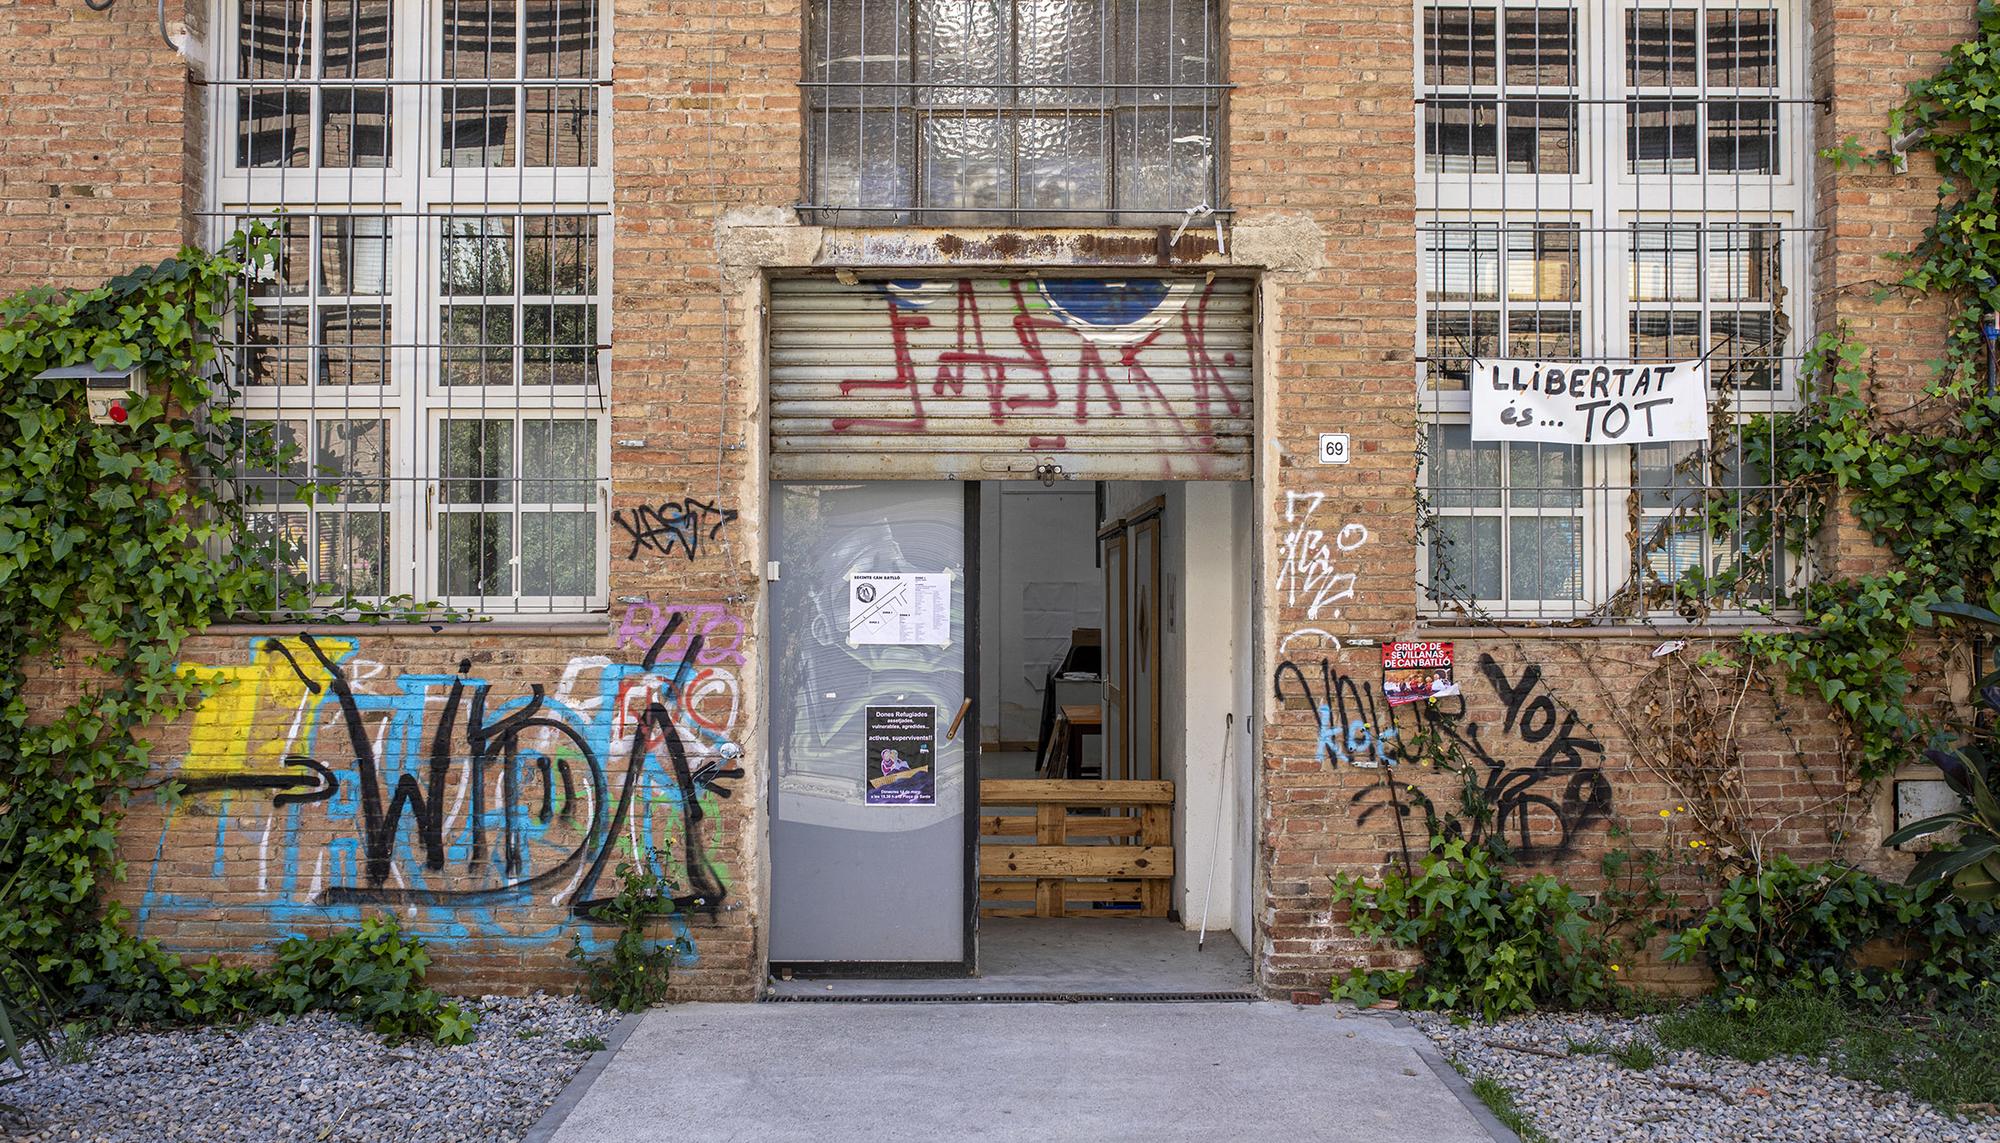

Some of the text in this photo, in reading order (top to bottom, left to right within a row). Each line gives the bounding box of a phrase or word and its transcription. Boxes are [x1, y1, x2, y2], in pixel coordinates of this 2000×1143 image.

[1576, 398, 1674, 442] TOT
[1326, 441, 1344, 456] 69
[1394, 643, 1427, 651] GRUPO
[1391, 650, 1444, 659] SEVILLANAS
[1385, 656, 1451, 668] DE CAN BATLLÓ
